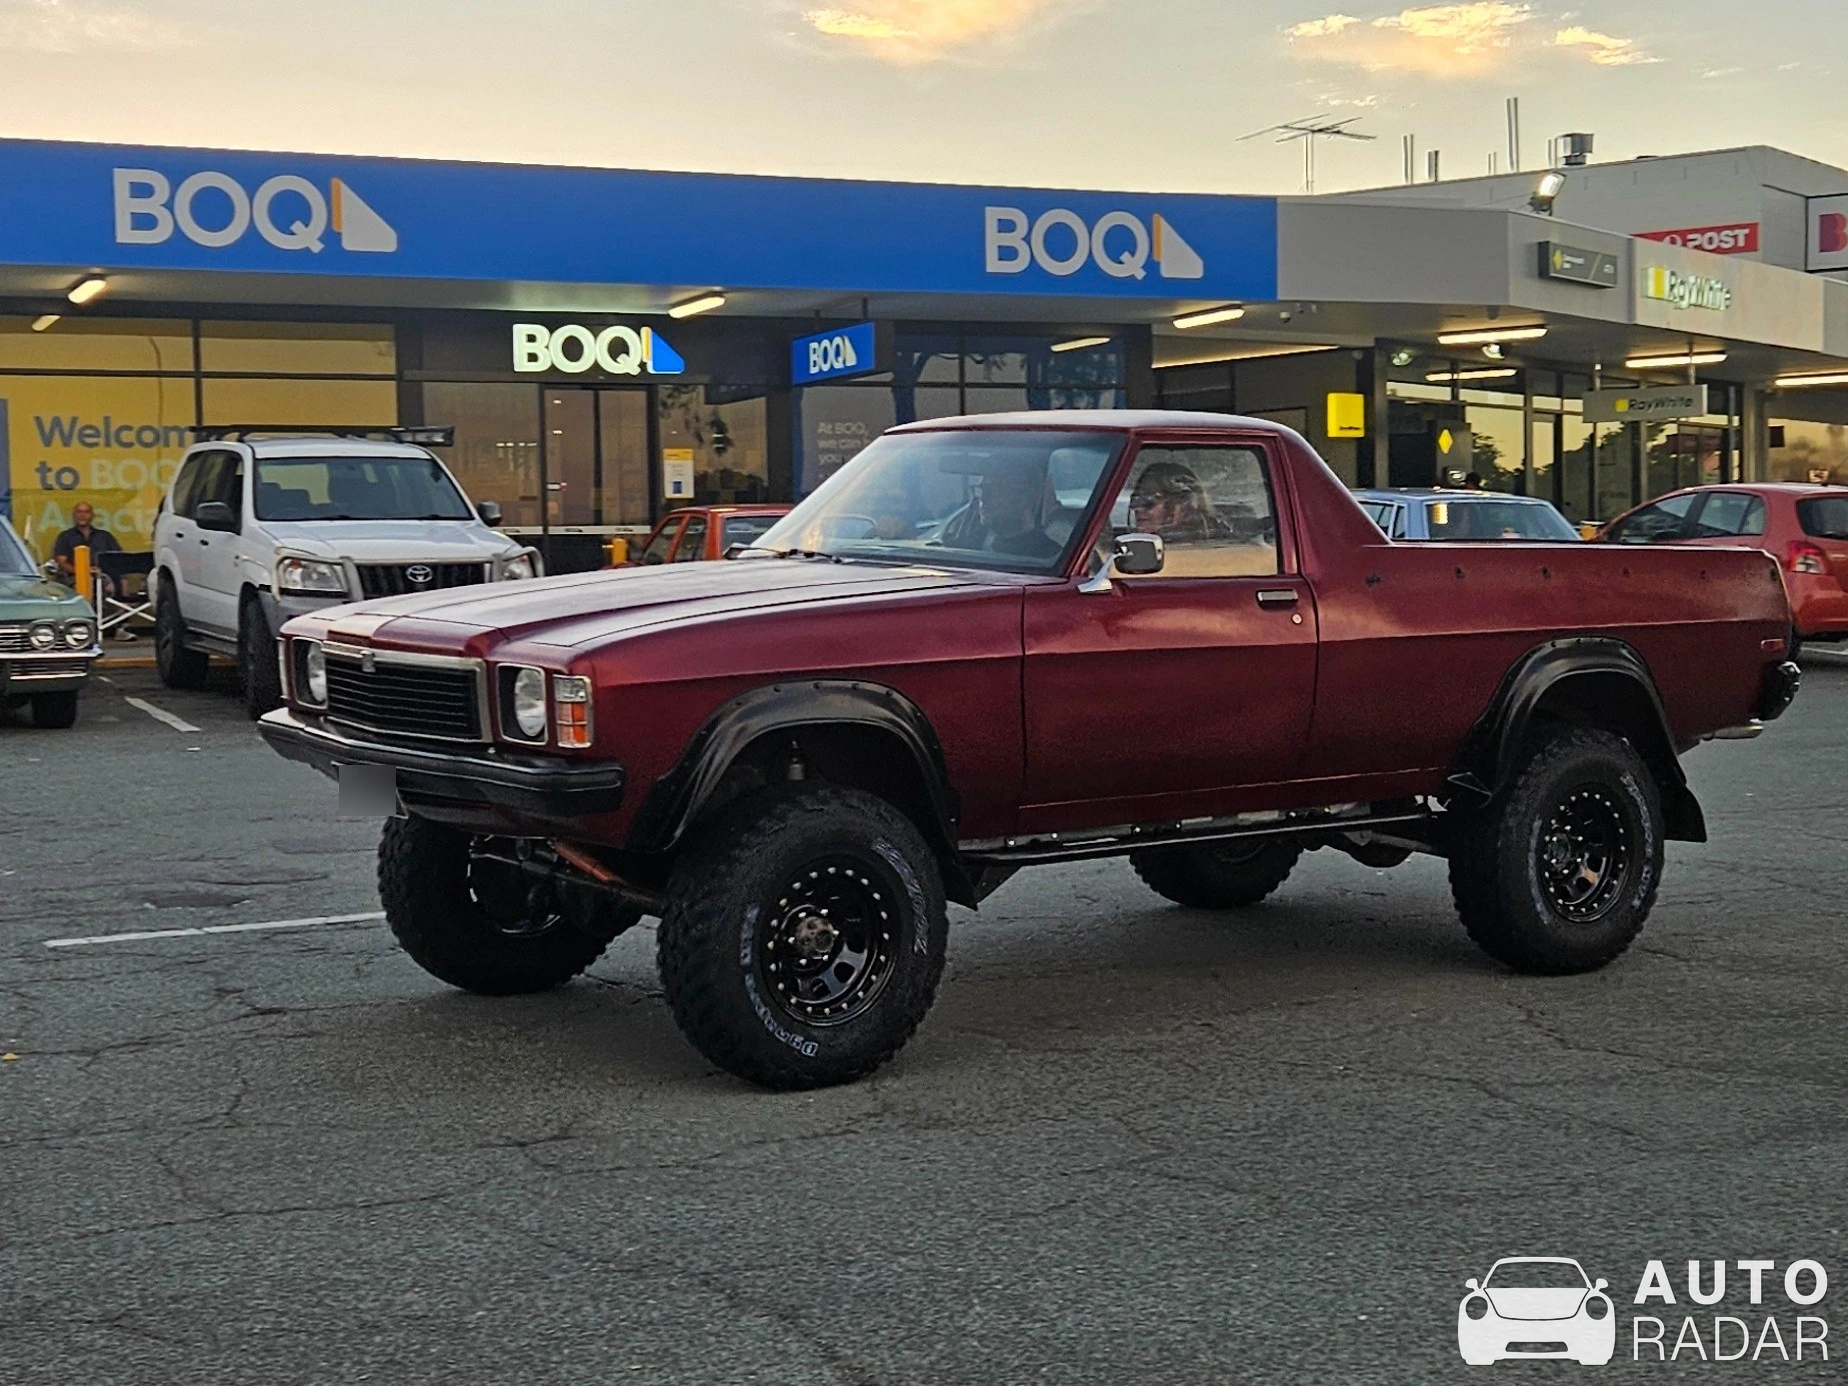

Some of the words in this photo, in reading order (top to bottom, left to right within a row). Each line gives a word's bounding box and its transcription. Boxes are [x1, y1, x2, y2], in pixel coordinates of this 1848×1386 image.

[113, 167, 325, 254] BOQ
[984, 206, 1150, 281] BOQ
[1686, 228, 1750, 251] POST
[512, 323, 642, 376] BOQ
[808, 336, 845, 374] BOQ
[34, 460, 80, 490] to
